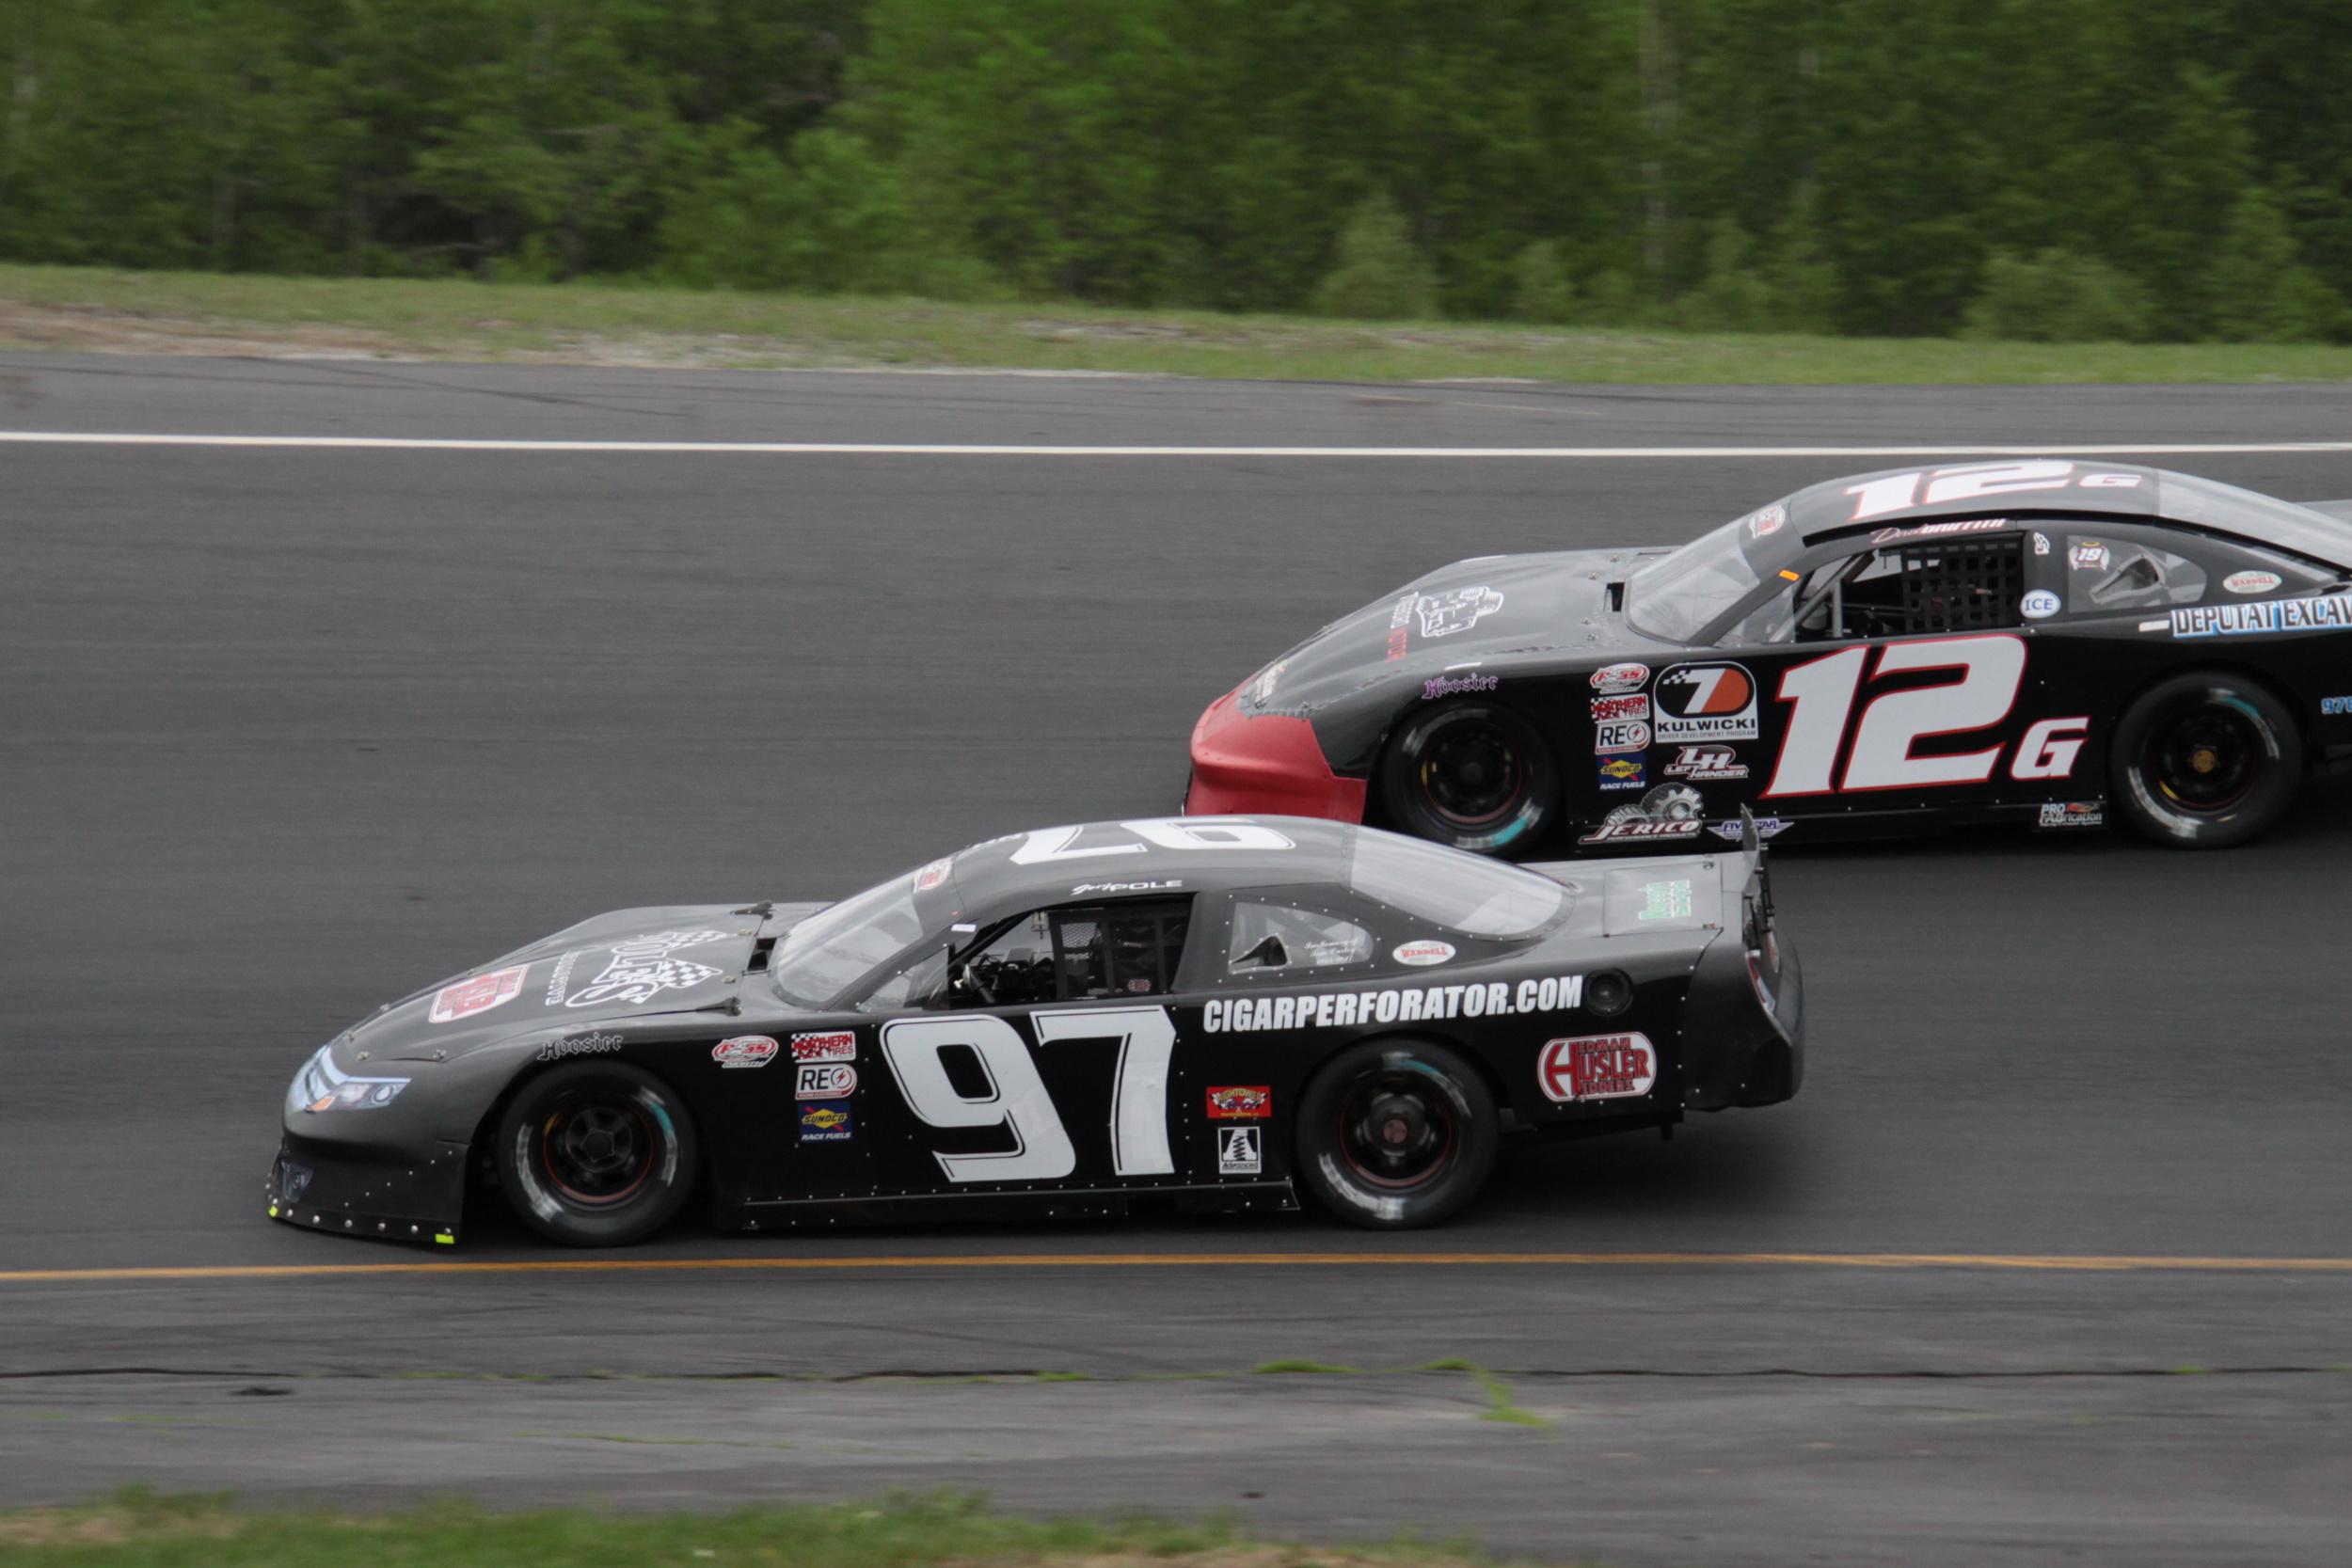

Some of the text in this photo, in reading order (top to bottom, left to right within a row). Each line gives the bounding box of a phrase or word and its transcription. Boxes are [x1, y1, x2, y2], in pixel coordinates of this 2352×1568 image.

[1844, 461, 2141, 521] 12 G
[2077, 547, 2104, 562] 19
[2024, 598, 2054, 612] ICE
[2171, 601, 2277, 639] DEPUTAT
[1422, 673, 1499, 699] Hoosier
[1757, 633, 2090, 799] 12 G
[1658, 719, 1756, 733] KULWICKI
[1603, 764, 1641, 774] SUNOCO
[1690, 769, 1747, 779] HANDER
[2041, 803, 2066, 815] PRO
[1583, 820, 1699, 841] JERICO
[1723, 822, 1742, 832] FIV
[1110, 879, 1183, 892] POLE
[1402, 946, 1449, 958] WADDELL
[1203, 975, 1582, 1033] CIGARPERFORATOR.COM
[537, 1032, 624, 1060] Hoosier
[793, 1034, 853, 1052] NORTHERN
[879, 1005, 1176, 1182] 97
[803, 1113, 846, 1124] SUNOCO
[802, 1132, 851, 1141] RACE FUELS
